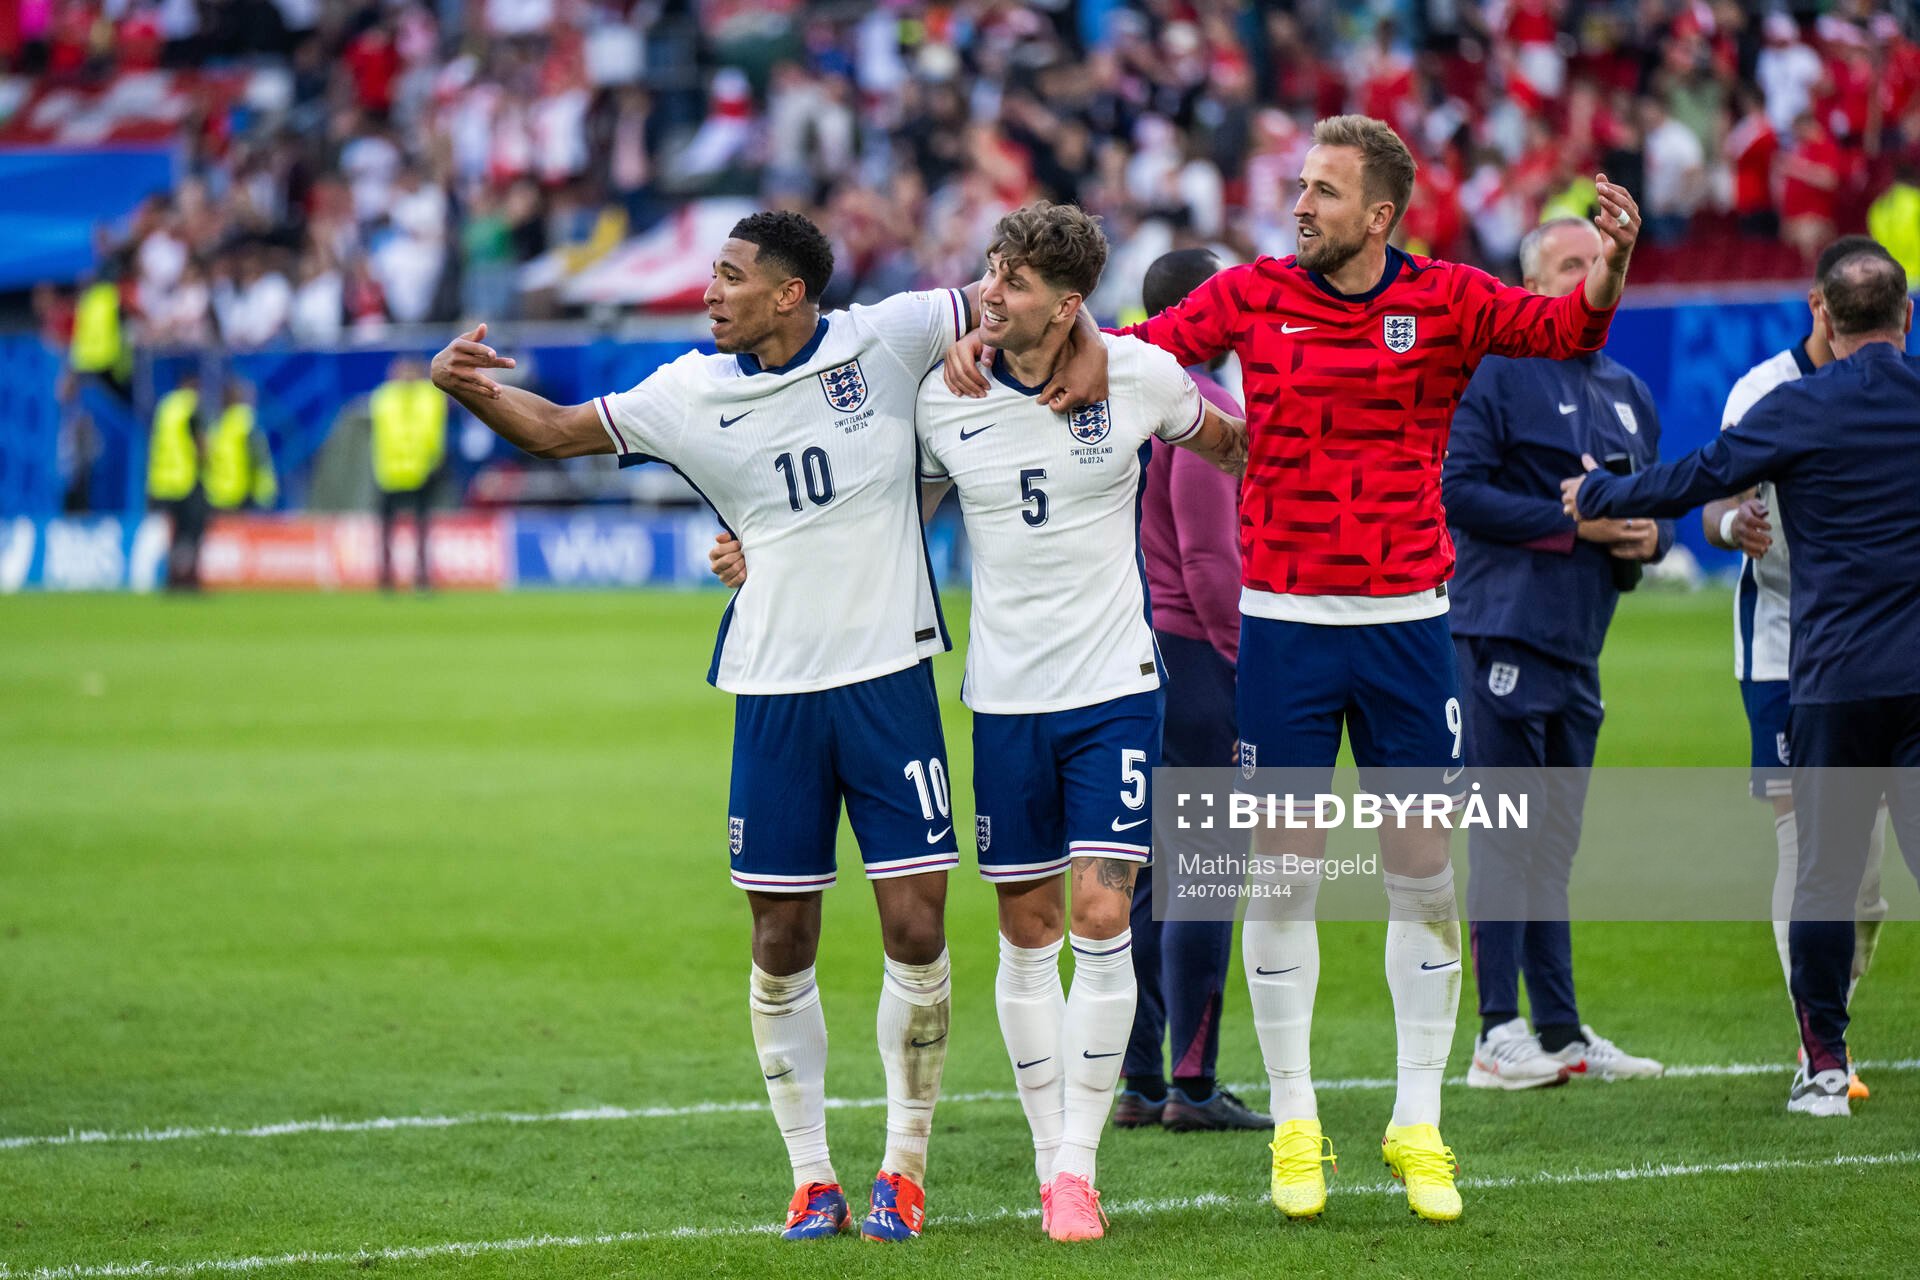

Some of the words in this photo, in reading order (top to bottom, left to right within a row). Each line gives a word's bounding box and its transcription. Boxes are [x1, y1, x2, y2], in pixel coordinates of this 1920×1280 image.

[834, 409, 875, 428] SWITZERLAND
[774, 446, 836, 512] 10
[1070, 446, 1113, 456] SWITZERLAND
[1079, 456, 1104, 464] 06.07.24
[1020, 468, 1049, 528] 5
[1445, 697, 1462, 759] 9
[903, 757, 949, 820] 10
[1120, 748, 1147, 811] 5
